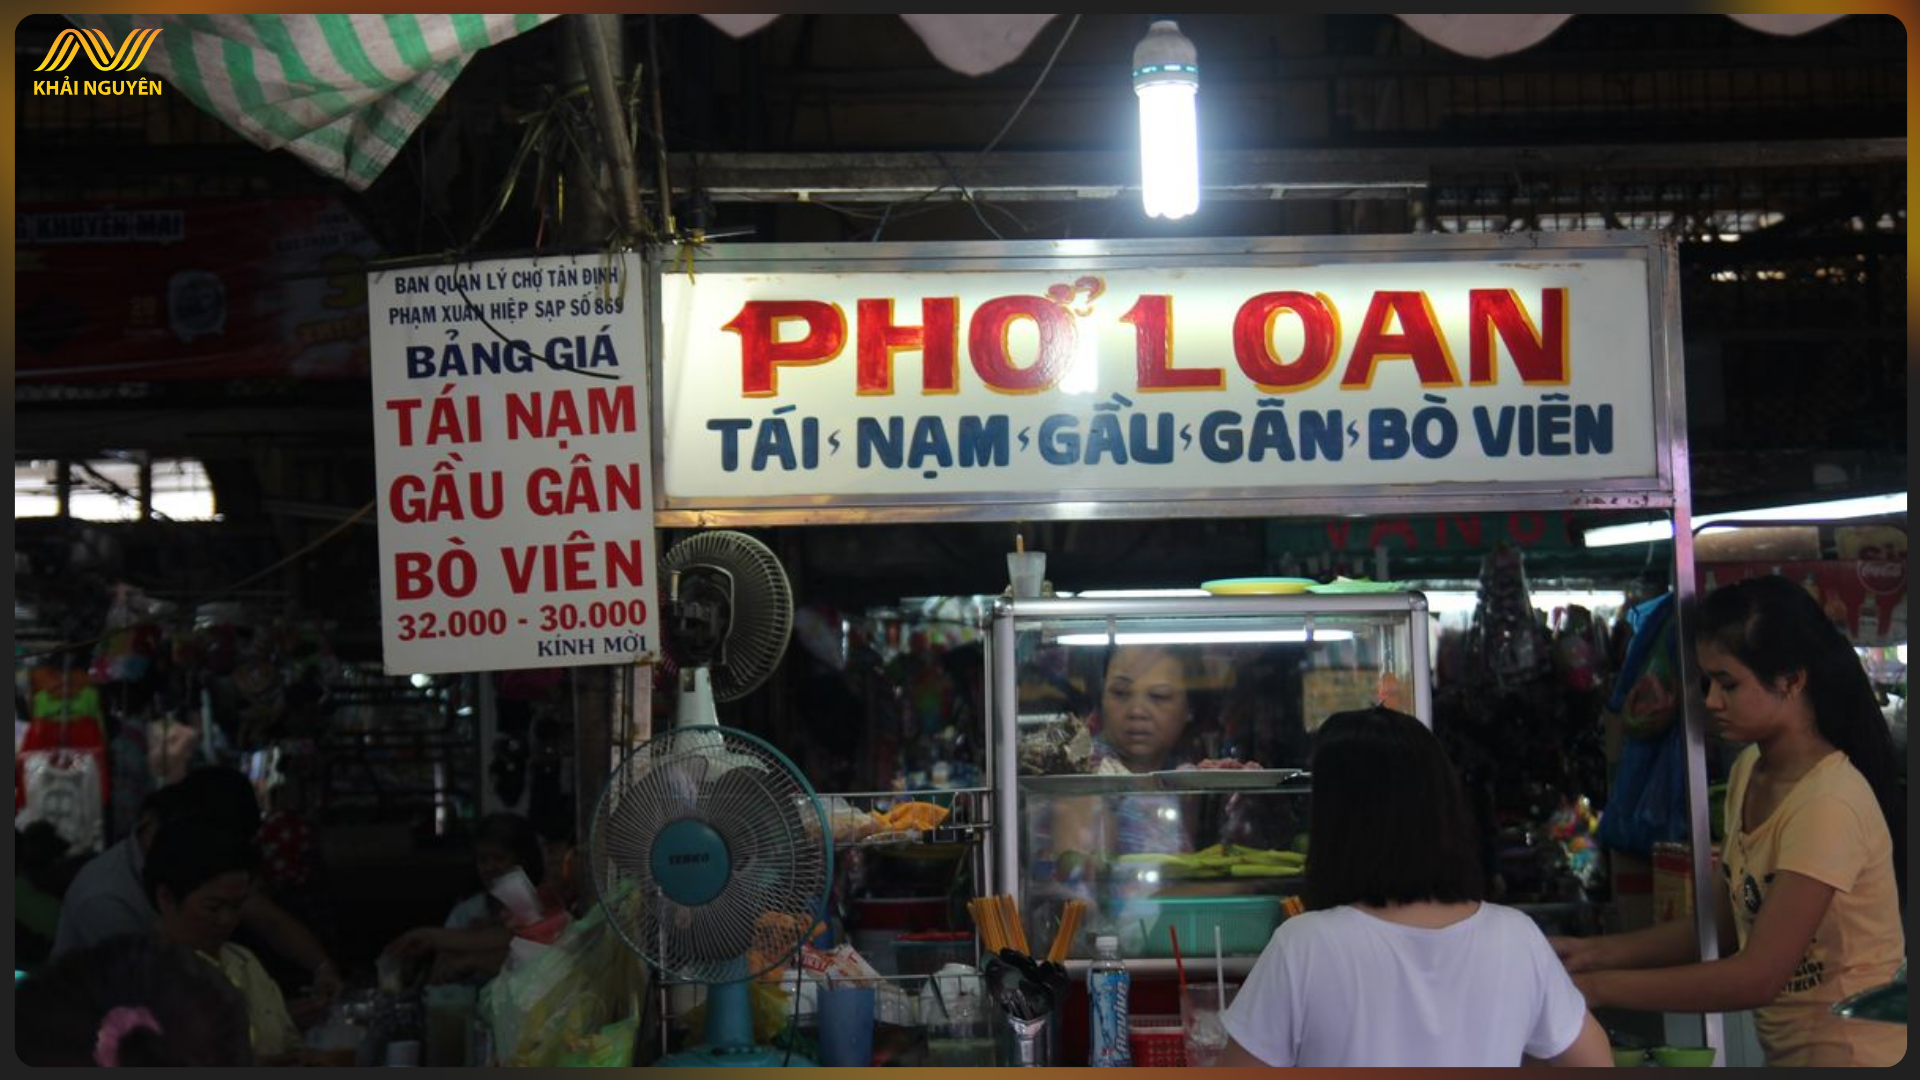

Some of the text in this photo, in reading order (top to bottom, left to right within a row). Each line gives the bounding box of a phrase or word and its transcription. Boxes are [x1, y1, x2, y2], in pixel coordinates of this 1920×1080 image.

[388, 305, 437, 330] PHẠM
[490, 297, 529, 325] HIỆP
[534, 298, 566, 323] SẠP
[570, 291, 591, 317] SỐ
[594, 296, 624, 316] 869
[394, 276, 430, 295] BAN
[486, 267, 508, 290] LÝ
[512, 267, 543, 293] CHỢ
[547, 264, 579, 288] TÂN
[582, 266, 618, 291] ĐỊNH
[406, 328, 534, 380] BẢNG
[544, 324, 619, 372] GIÁ
[720, 274, 1571, 398] PHỞ LOAN
[386, 382, 637, 450] TÁI NẠM
[705, 403, 820, 473] TÁI
[856, 411, 1010, 480] NẠM
[1037, 391, 1175, 467] GẦU
[1368, 392, 1460, 462] BÒ
[388, 451, 642, 524] GẦU GÂN
[394, 529, 644, 601] BÒ VIÊN
[397, 607, 507, 642] 32.000
[539, 598, 647, 633] 30.000
[537, 629, 647, 658] KÍNH MỜI
